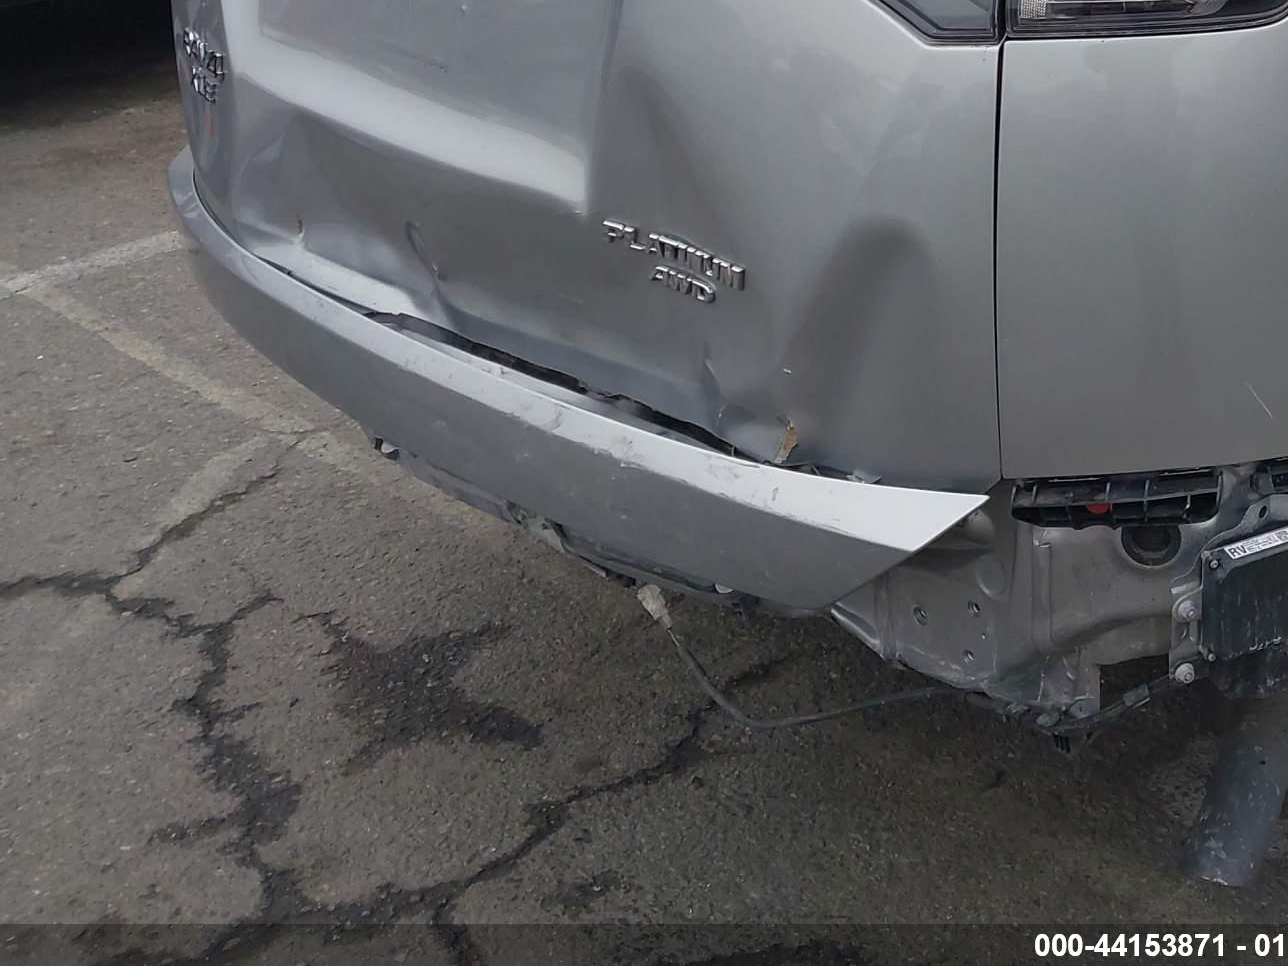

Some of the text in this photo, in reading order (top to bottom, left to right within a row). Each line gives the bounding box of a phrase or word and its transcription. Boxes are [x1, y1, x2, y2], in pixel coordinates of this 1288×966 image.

[602, 219, 746, 290] PLATINUM
[651, 264, 716, 303] AWD
[1227, 544, 1247, 557] RV
